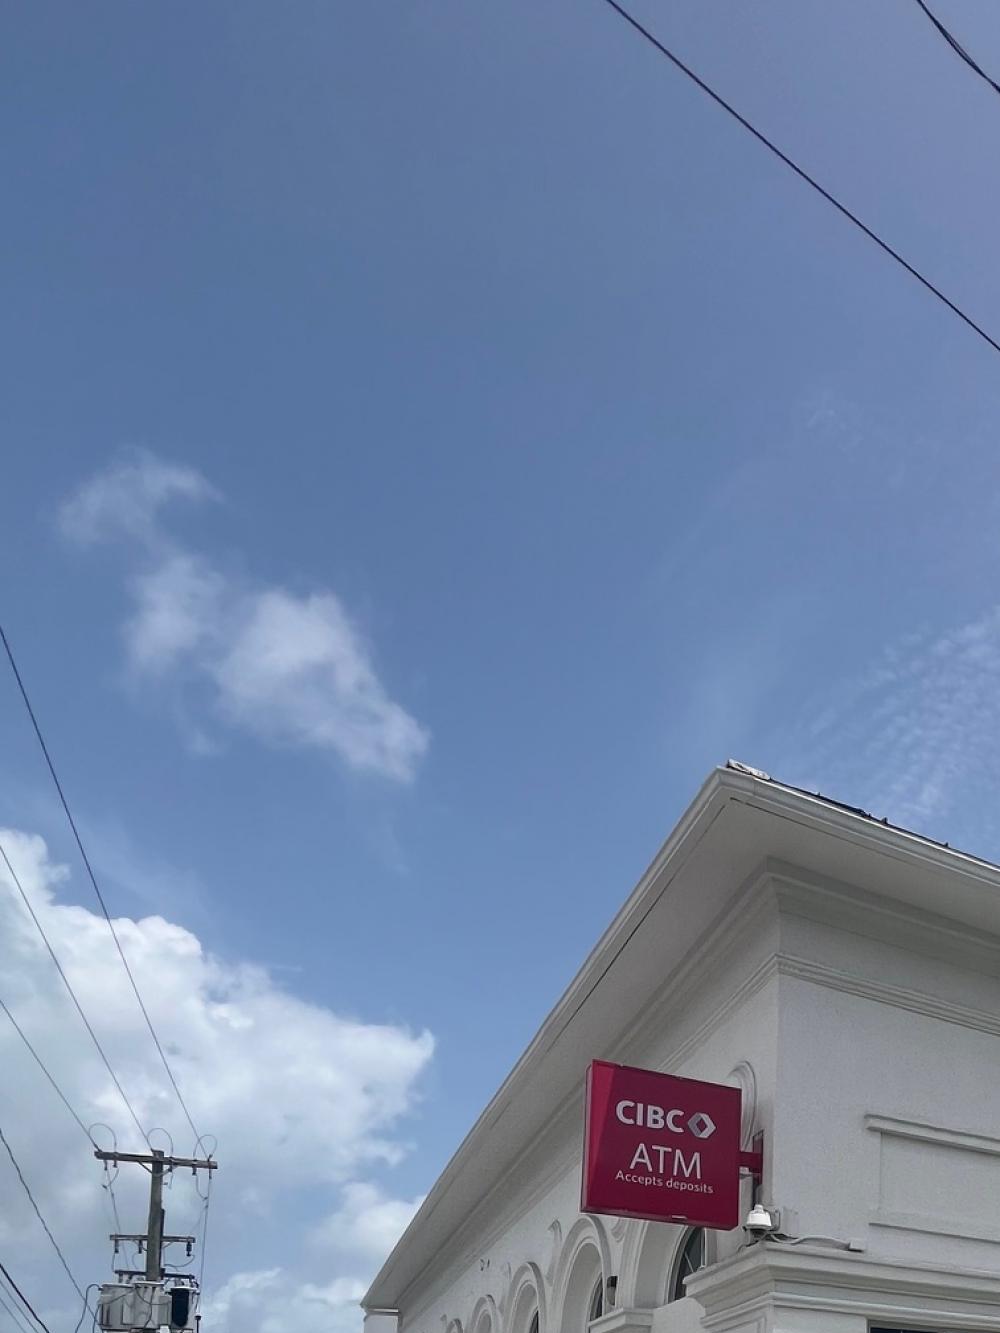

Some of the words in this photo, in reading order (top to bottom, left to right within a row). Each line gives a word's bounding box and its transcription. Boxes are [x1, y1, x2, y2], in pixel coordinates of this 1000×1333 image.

[616, 1100, 684, 1133] CIBC
[629, 1143, 702, 1179] ATM
[615, 1170, 663, 1187] Accepts
[666, 1178, 714, 1194] deposits
